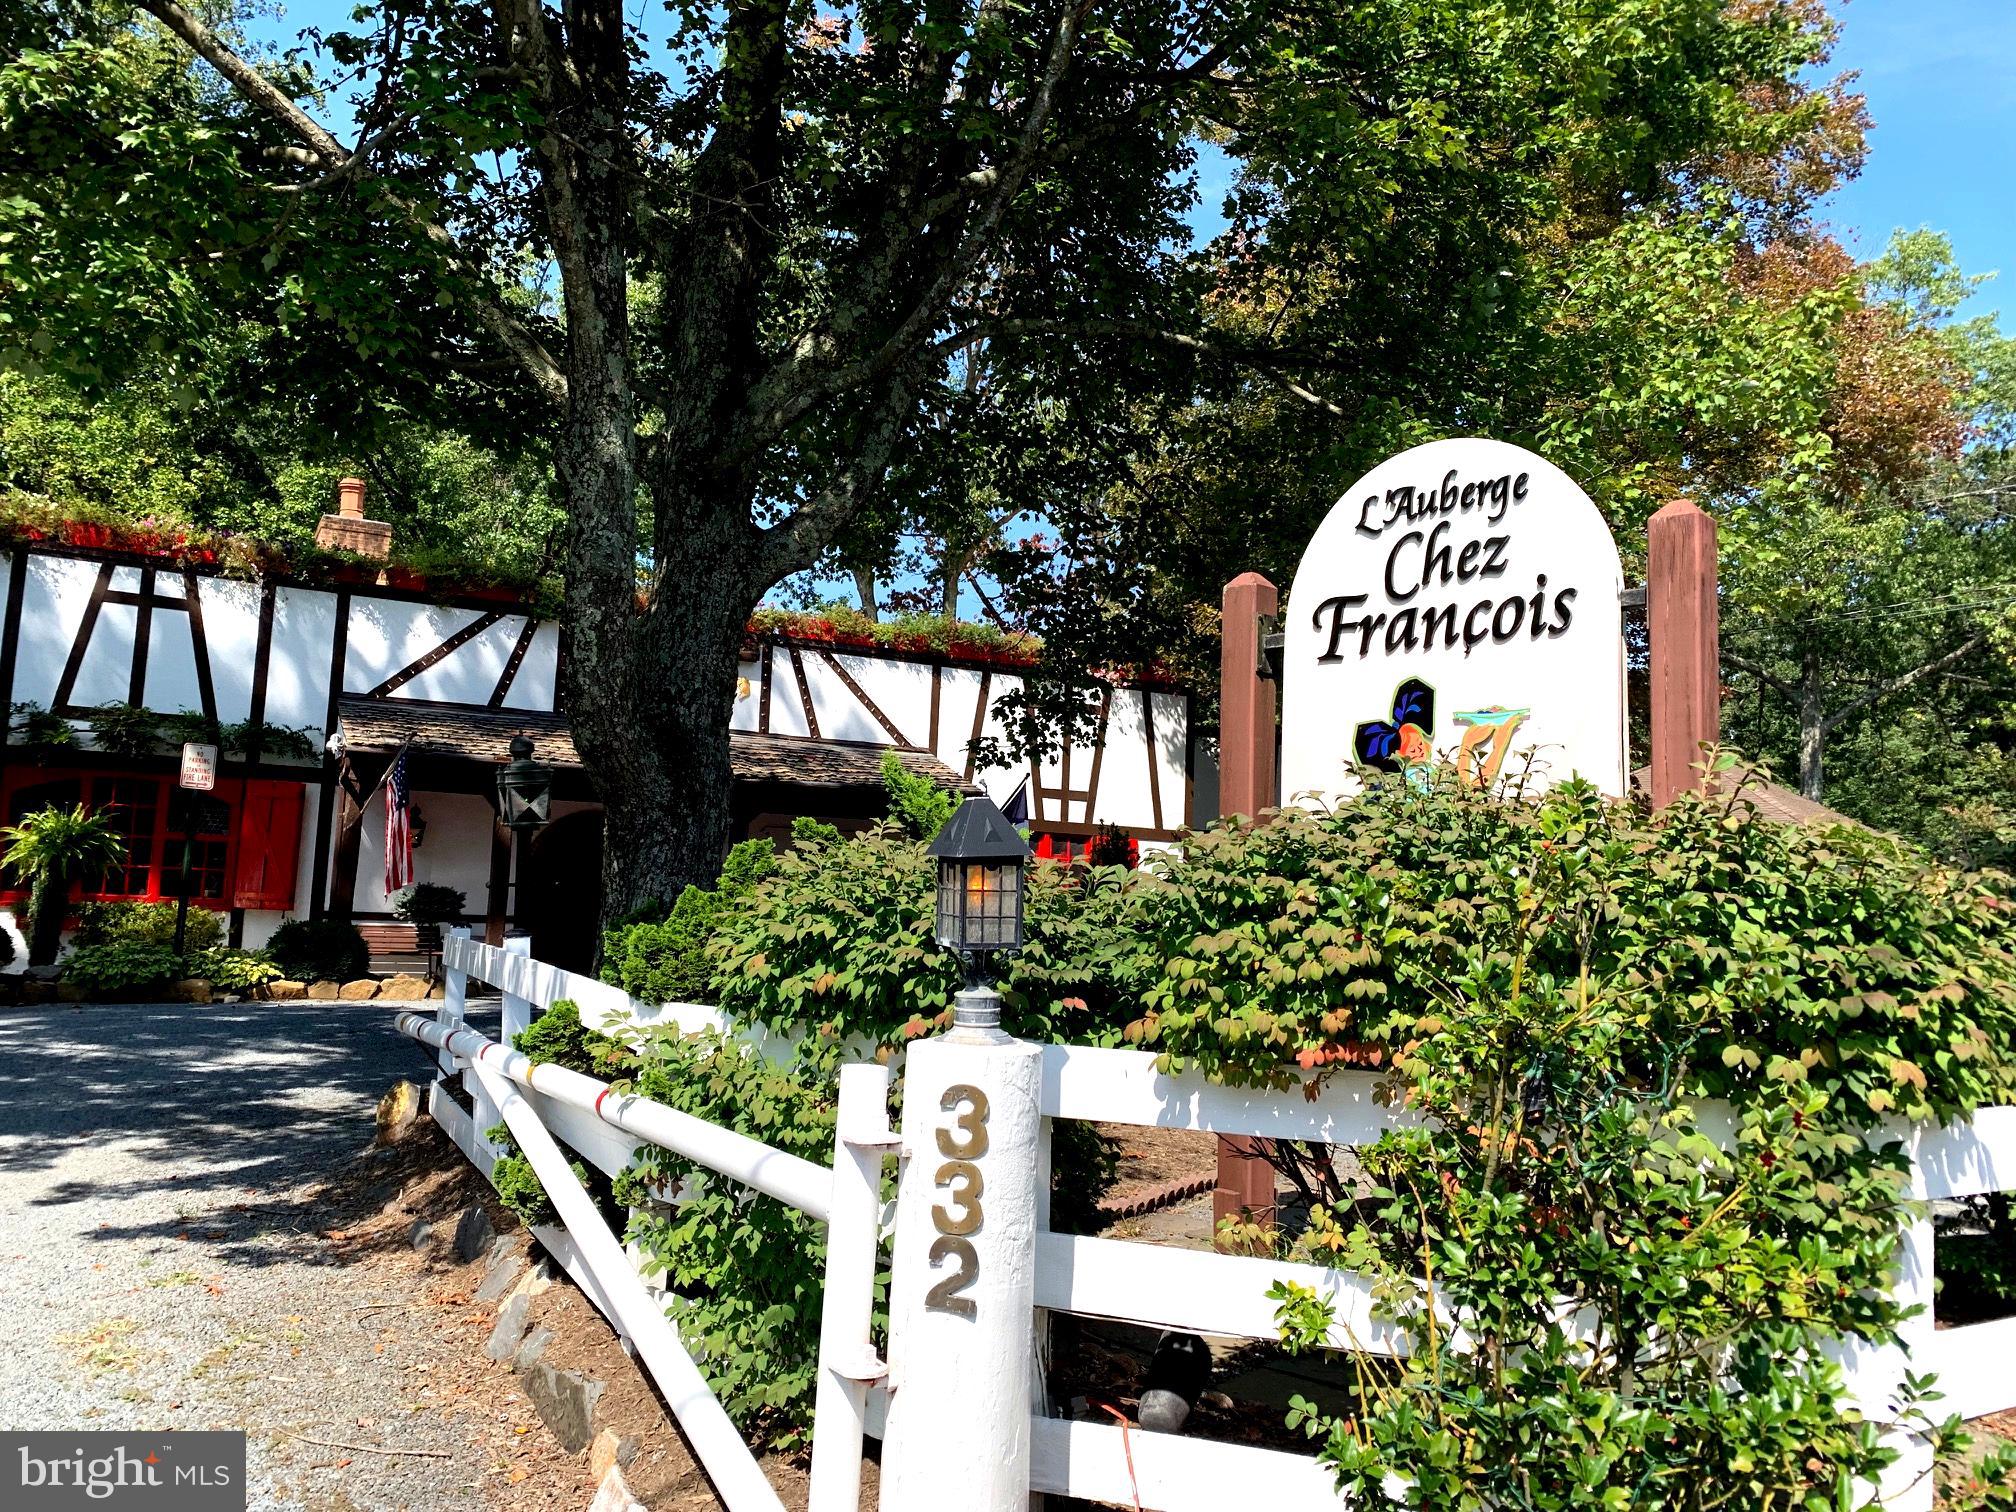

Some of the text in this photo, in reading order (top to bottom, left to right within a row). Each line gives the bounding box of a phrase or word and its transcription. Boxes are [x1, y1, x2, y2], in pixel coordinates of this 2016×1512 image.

[1355, 469, 1529, 535] L'Auberge
[1384, 521, 1511, 601] Chez
[1312, 573, 1578, 663] François
[183, 773, 211, 782] FIRE LANE
[185, 766, 211, 775] STANDING
[188, 757, 210, 765] PARKING
[924, 1083, 990, 1318] 332
